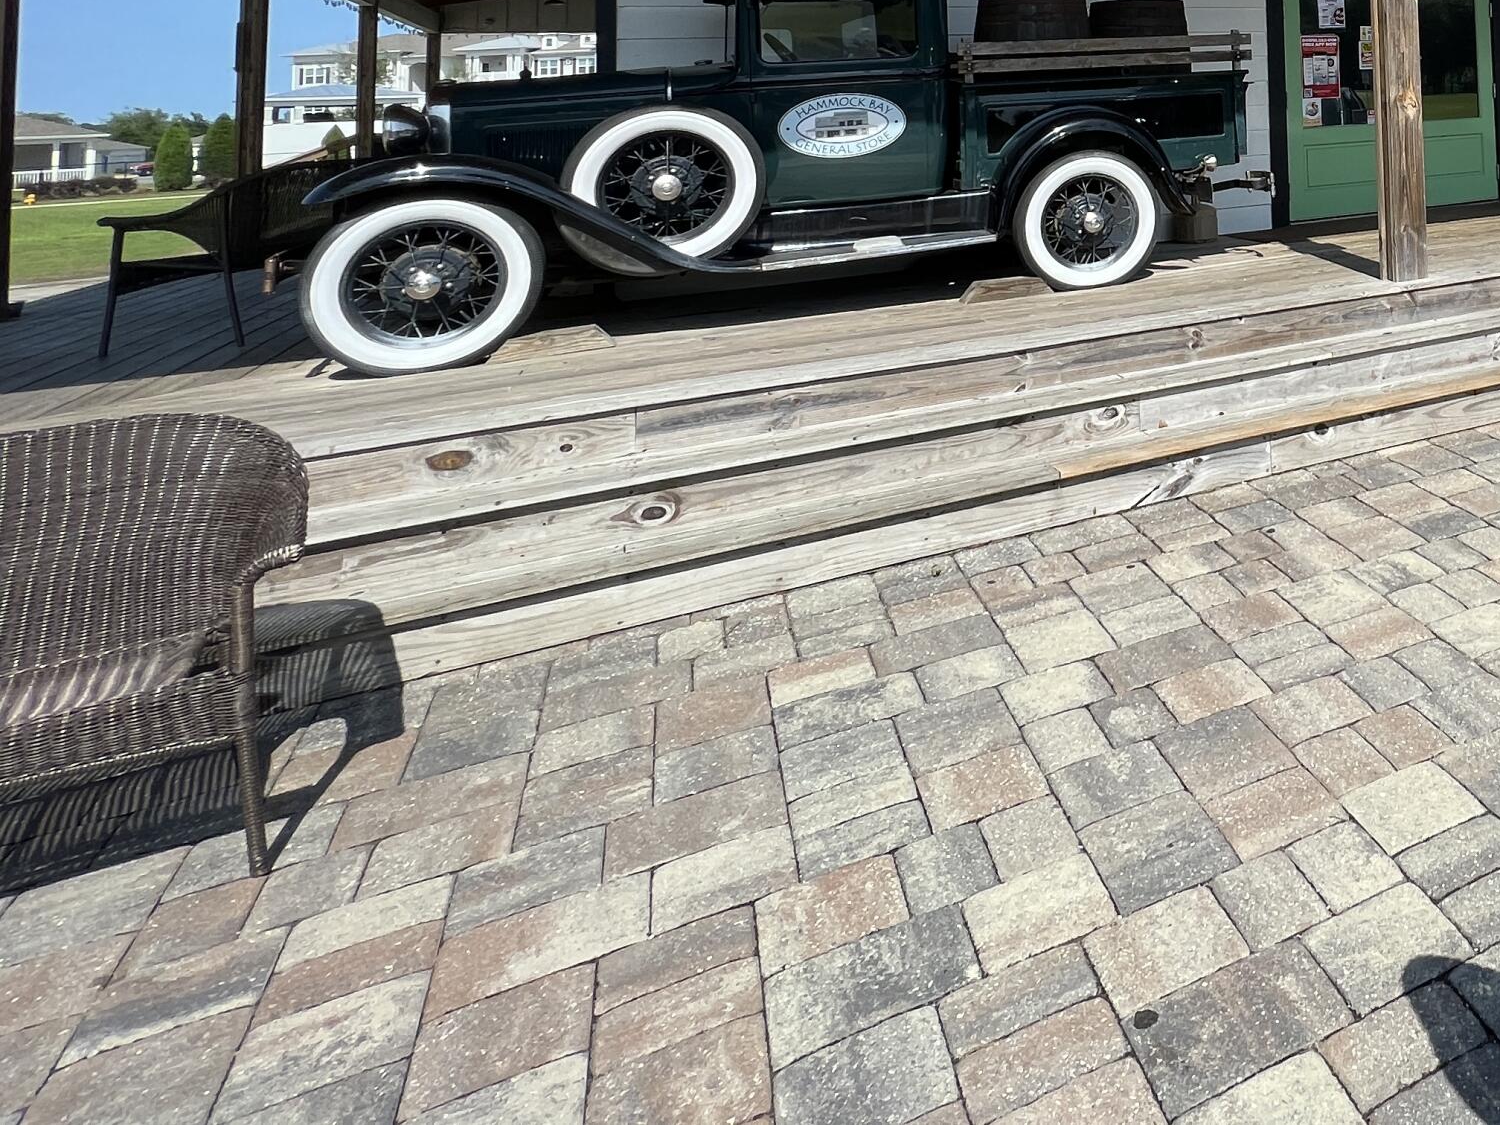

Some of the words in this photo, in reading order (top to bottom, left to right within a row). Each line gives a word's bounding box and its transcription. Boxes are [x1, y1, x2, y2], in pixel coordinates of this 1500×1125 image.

[795, 96, 866, 119] HAMMOCK
[868, 98, 895, 115] BAY
[795, 138, 855, 155] GENERAL
[855, 132, 893, 151] STORE
